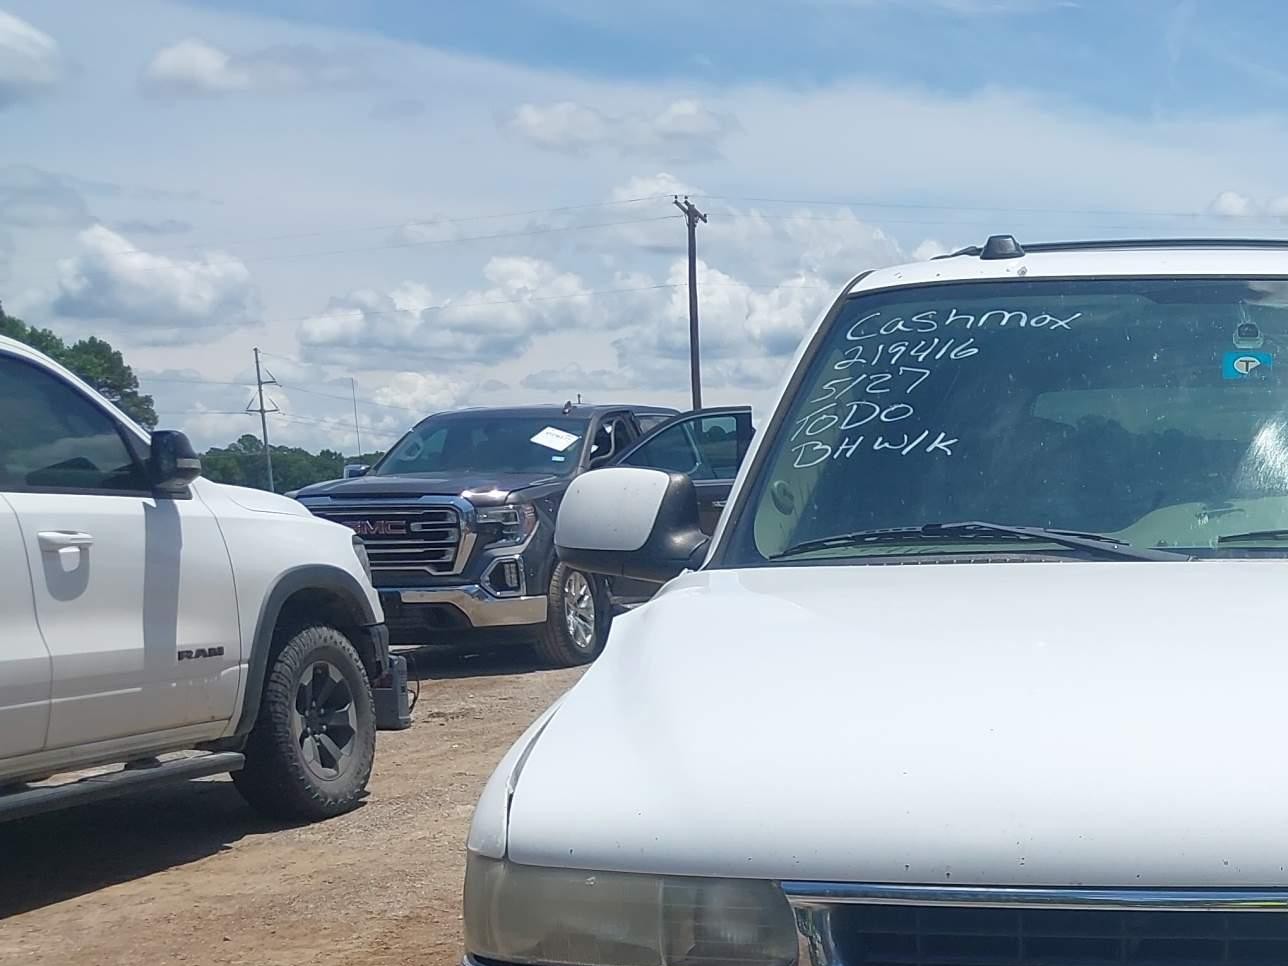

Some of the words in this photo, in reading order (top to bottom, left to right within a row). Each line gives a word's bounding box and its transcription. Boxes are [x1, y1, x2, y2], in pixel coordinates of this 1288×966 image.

[834, 337, 979, 370] 219416
[810, 366, 931, 404] 5/27
[178, 646, 224, 660] RAM
